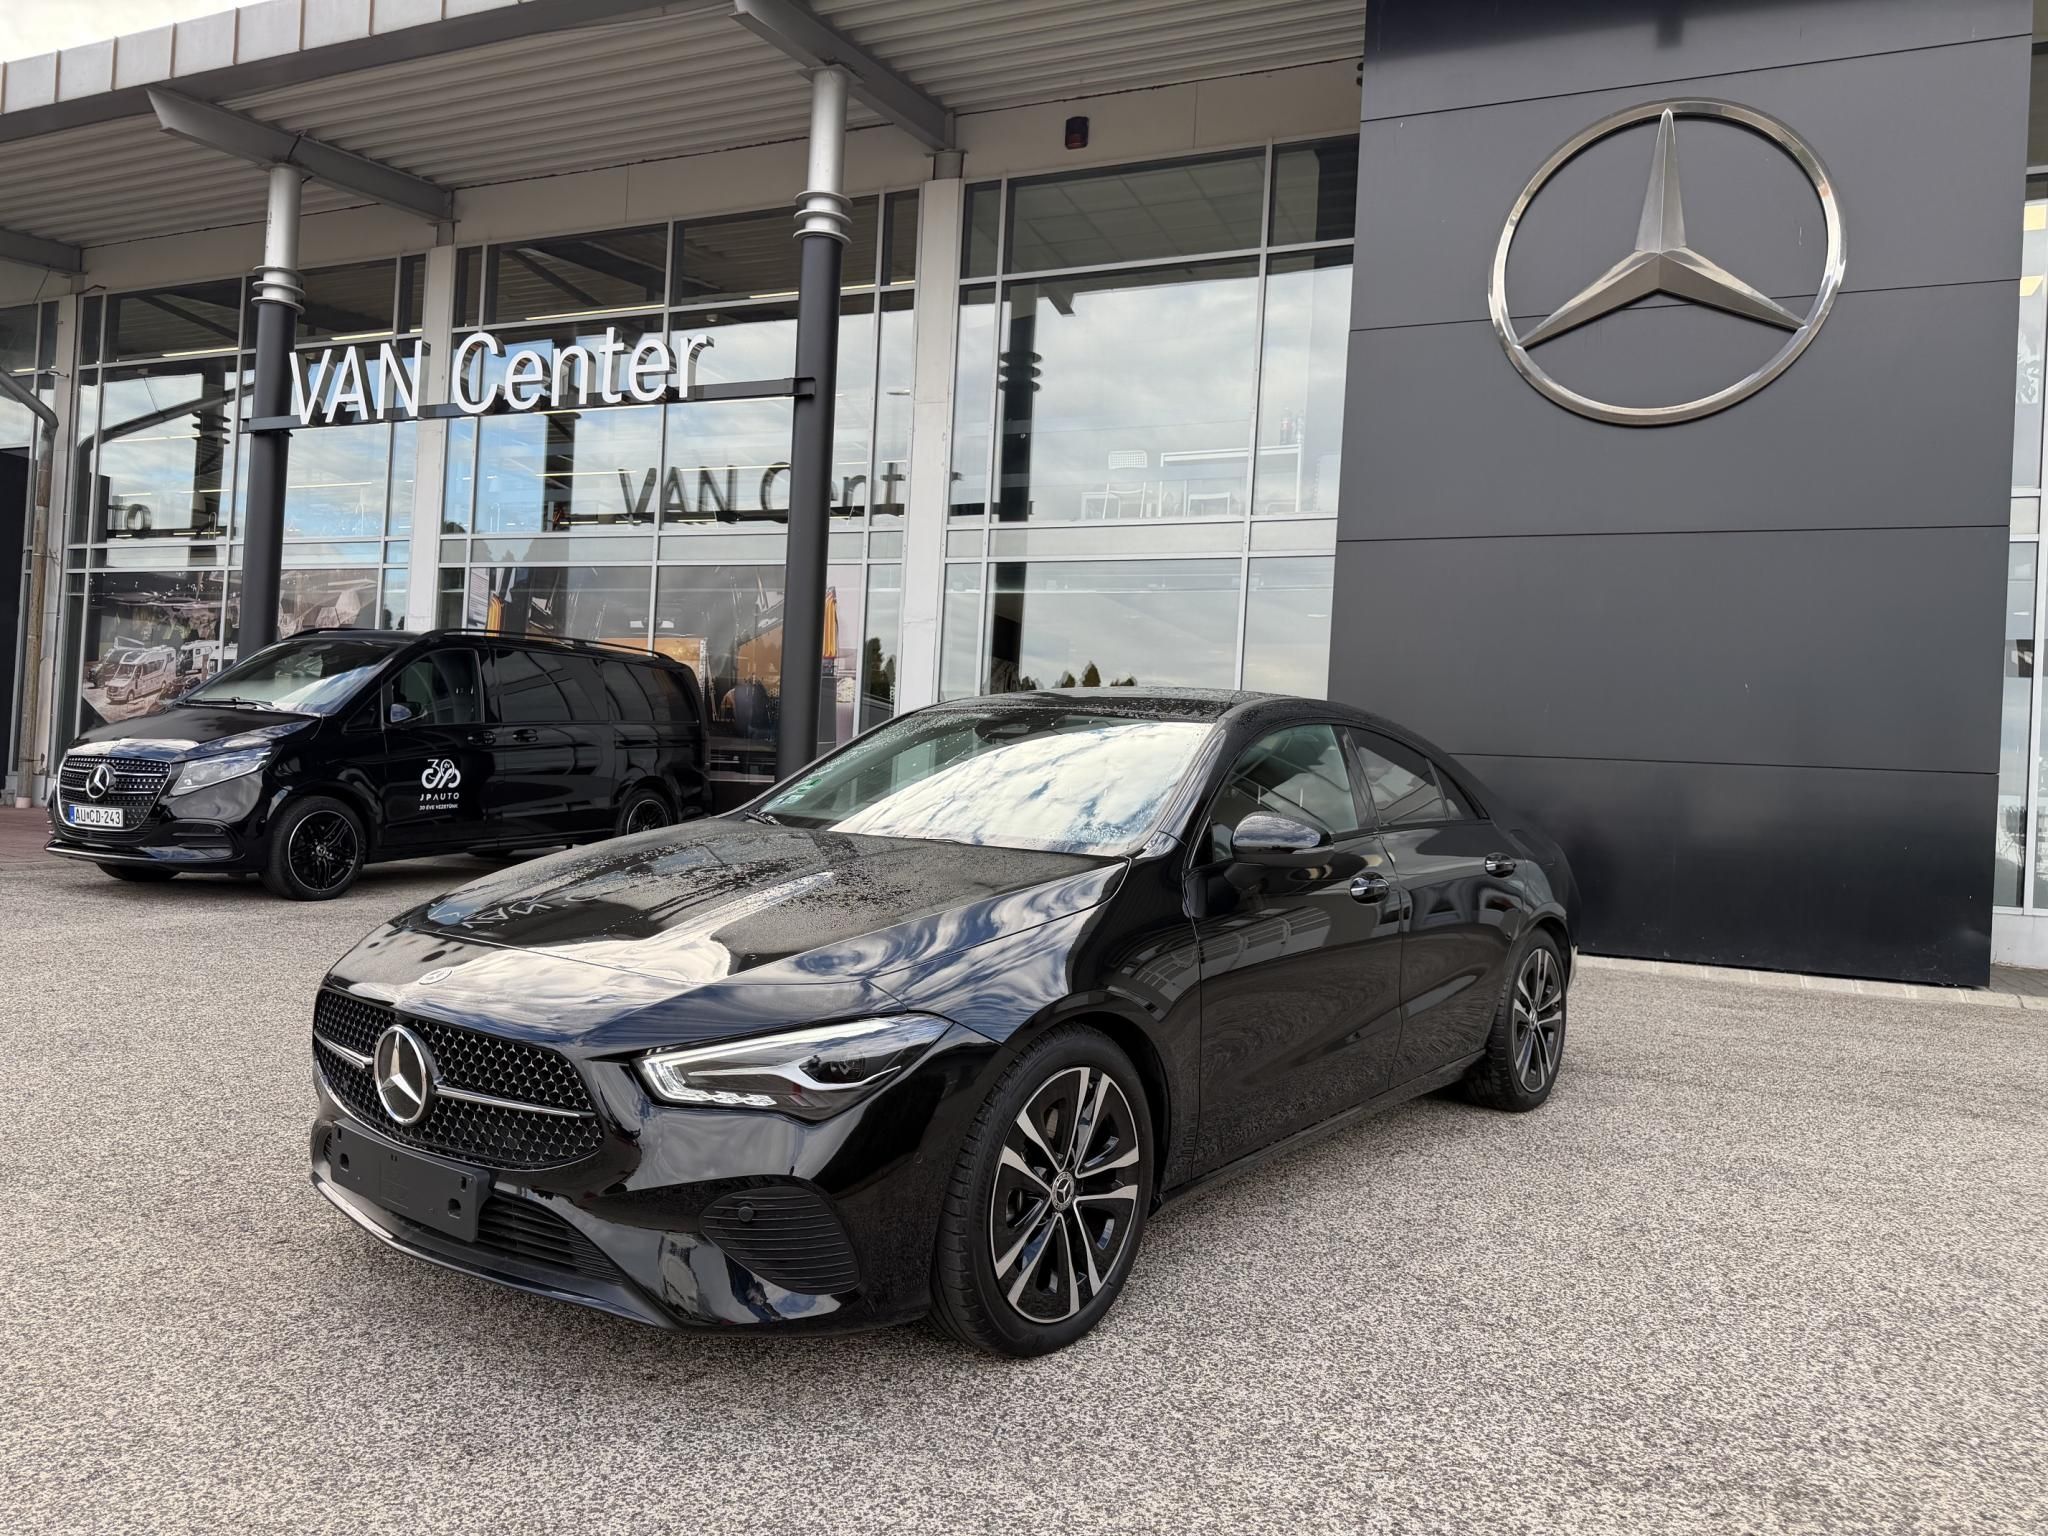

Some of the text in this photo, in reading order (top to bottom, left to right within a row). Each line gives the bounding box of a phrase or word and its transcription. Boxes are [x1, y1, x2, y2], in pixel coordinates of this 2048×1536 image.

[289, 326, 714, 425] VAN Center
[617, 464, 738, 524] VAN
